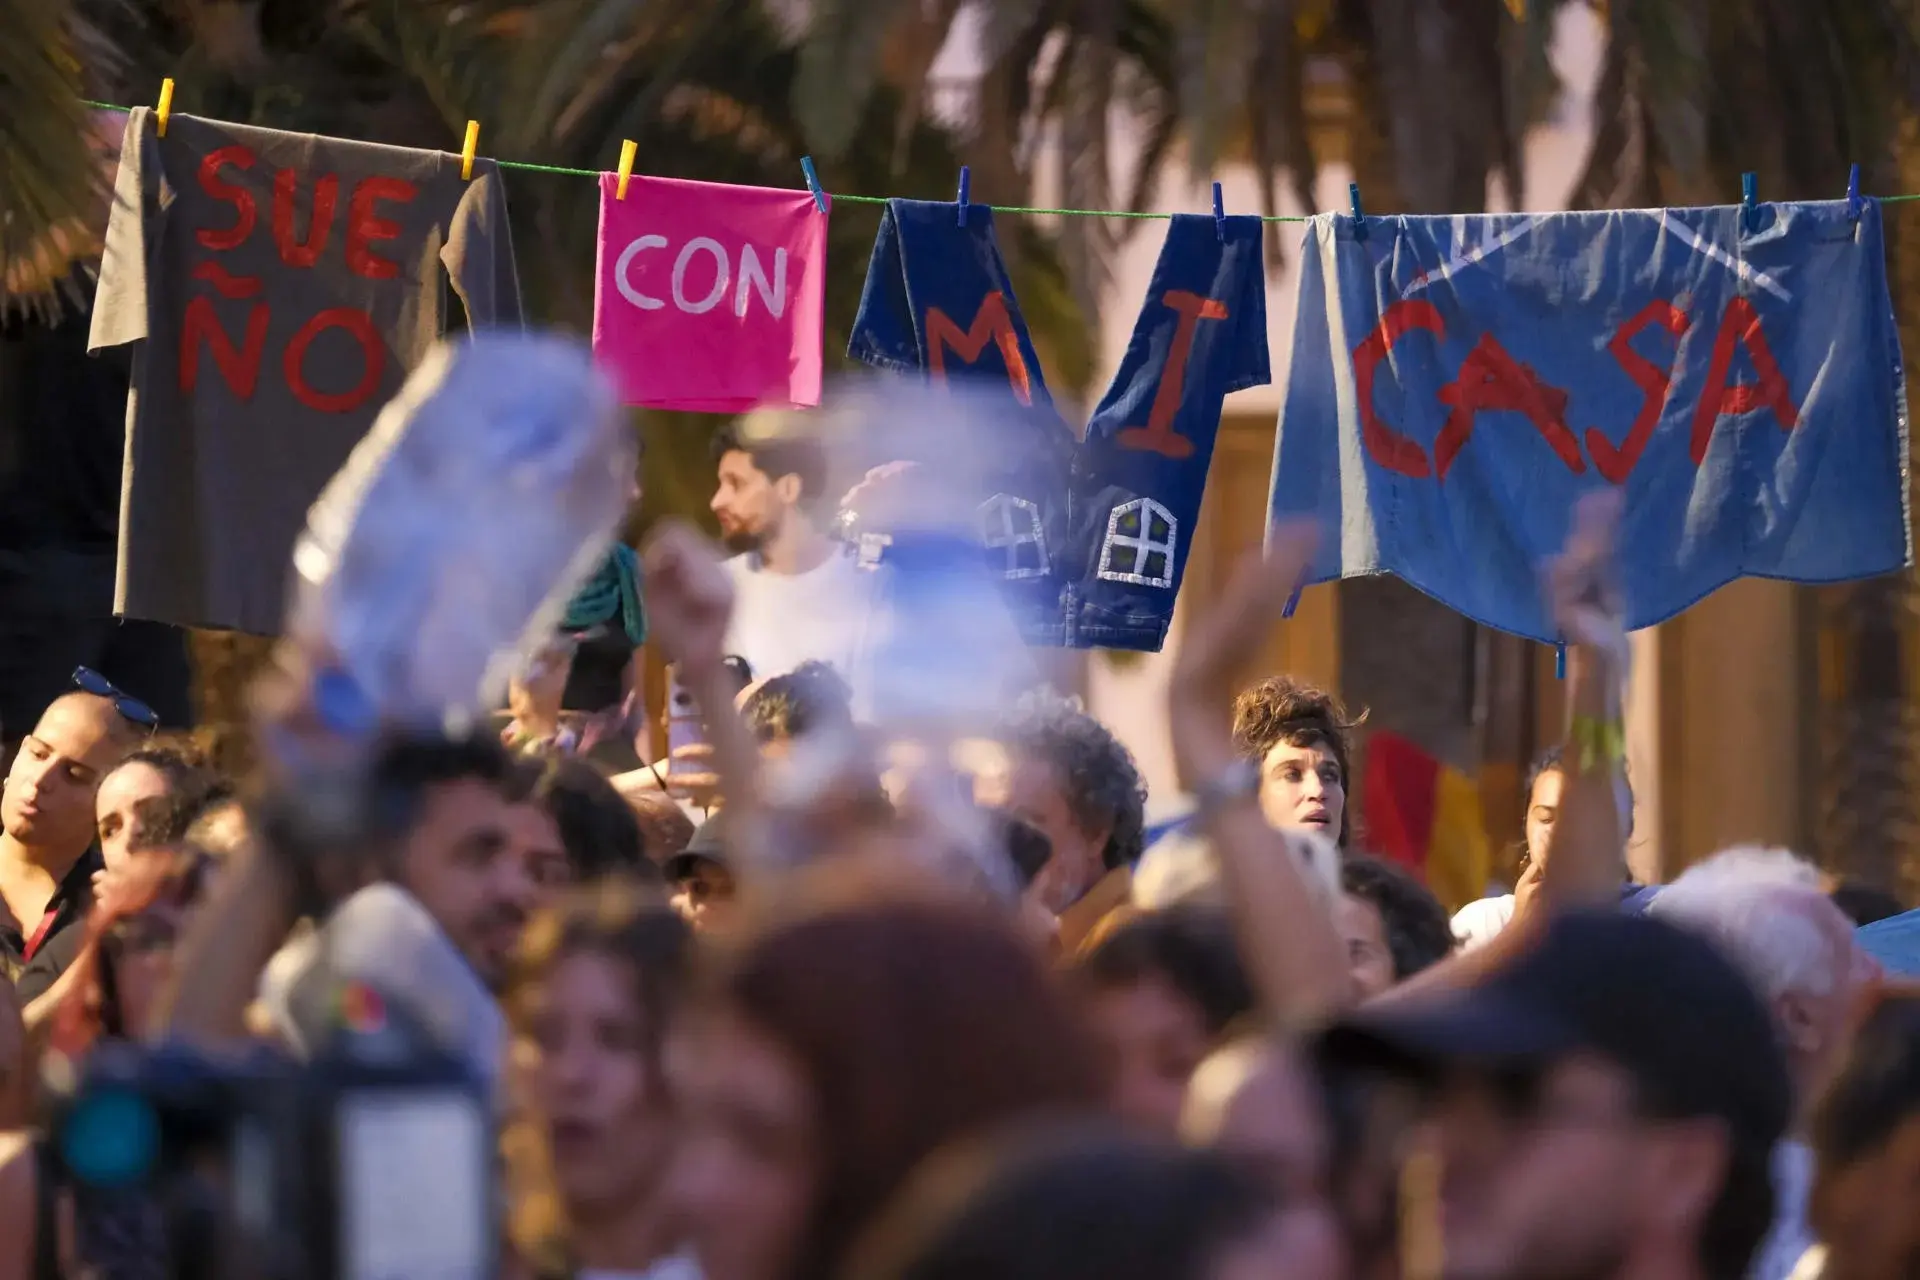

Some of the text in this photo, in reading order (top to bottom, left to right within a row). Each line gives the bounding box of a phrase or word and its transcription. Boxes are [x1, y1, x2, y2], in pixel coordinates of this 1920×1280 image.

[195, 145, 418, 279] SUE
[615, 234, 788, 319] CON
[179, 261, 387, 413] ÑO
[1352, 293, 1800, 485] CASA
